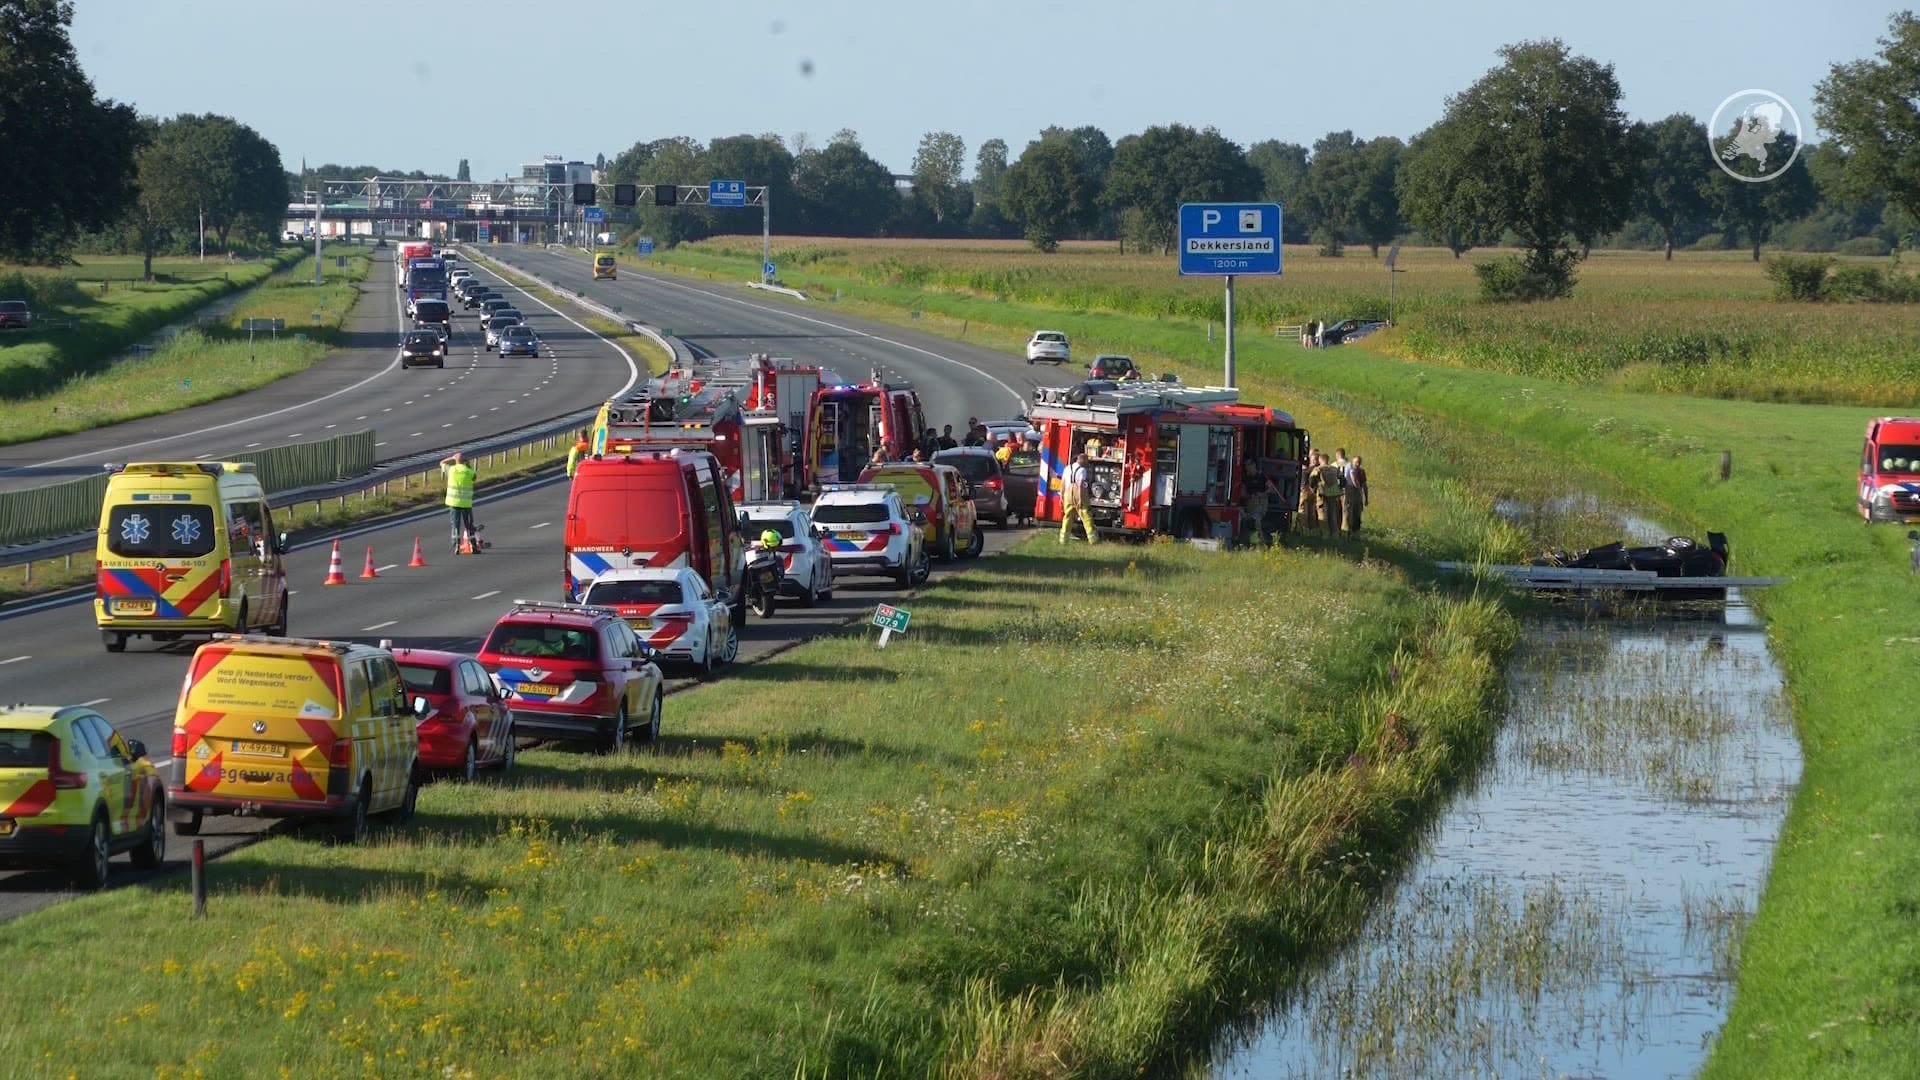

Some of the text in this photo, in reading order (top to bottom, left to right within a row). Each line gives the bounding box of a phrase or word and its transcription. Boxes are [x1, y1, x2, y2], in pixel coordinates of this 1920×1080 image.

[1202, 209, 1221, 233] P
[1190, 240, 1270, 250] Dekkersland
[1214, 260, 1237, 268] 1200
[876, 615, 899, 628] 107.9
[244, 670, 283, 680] Nederland
